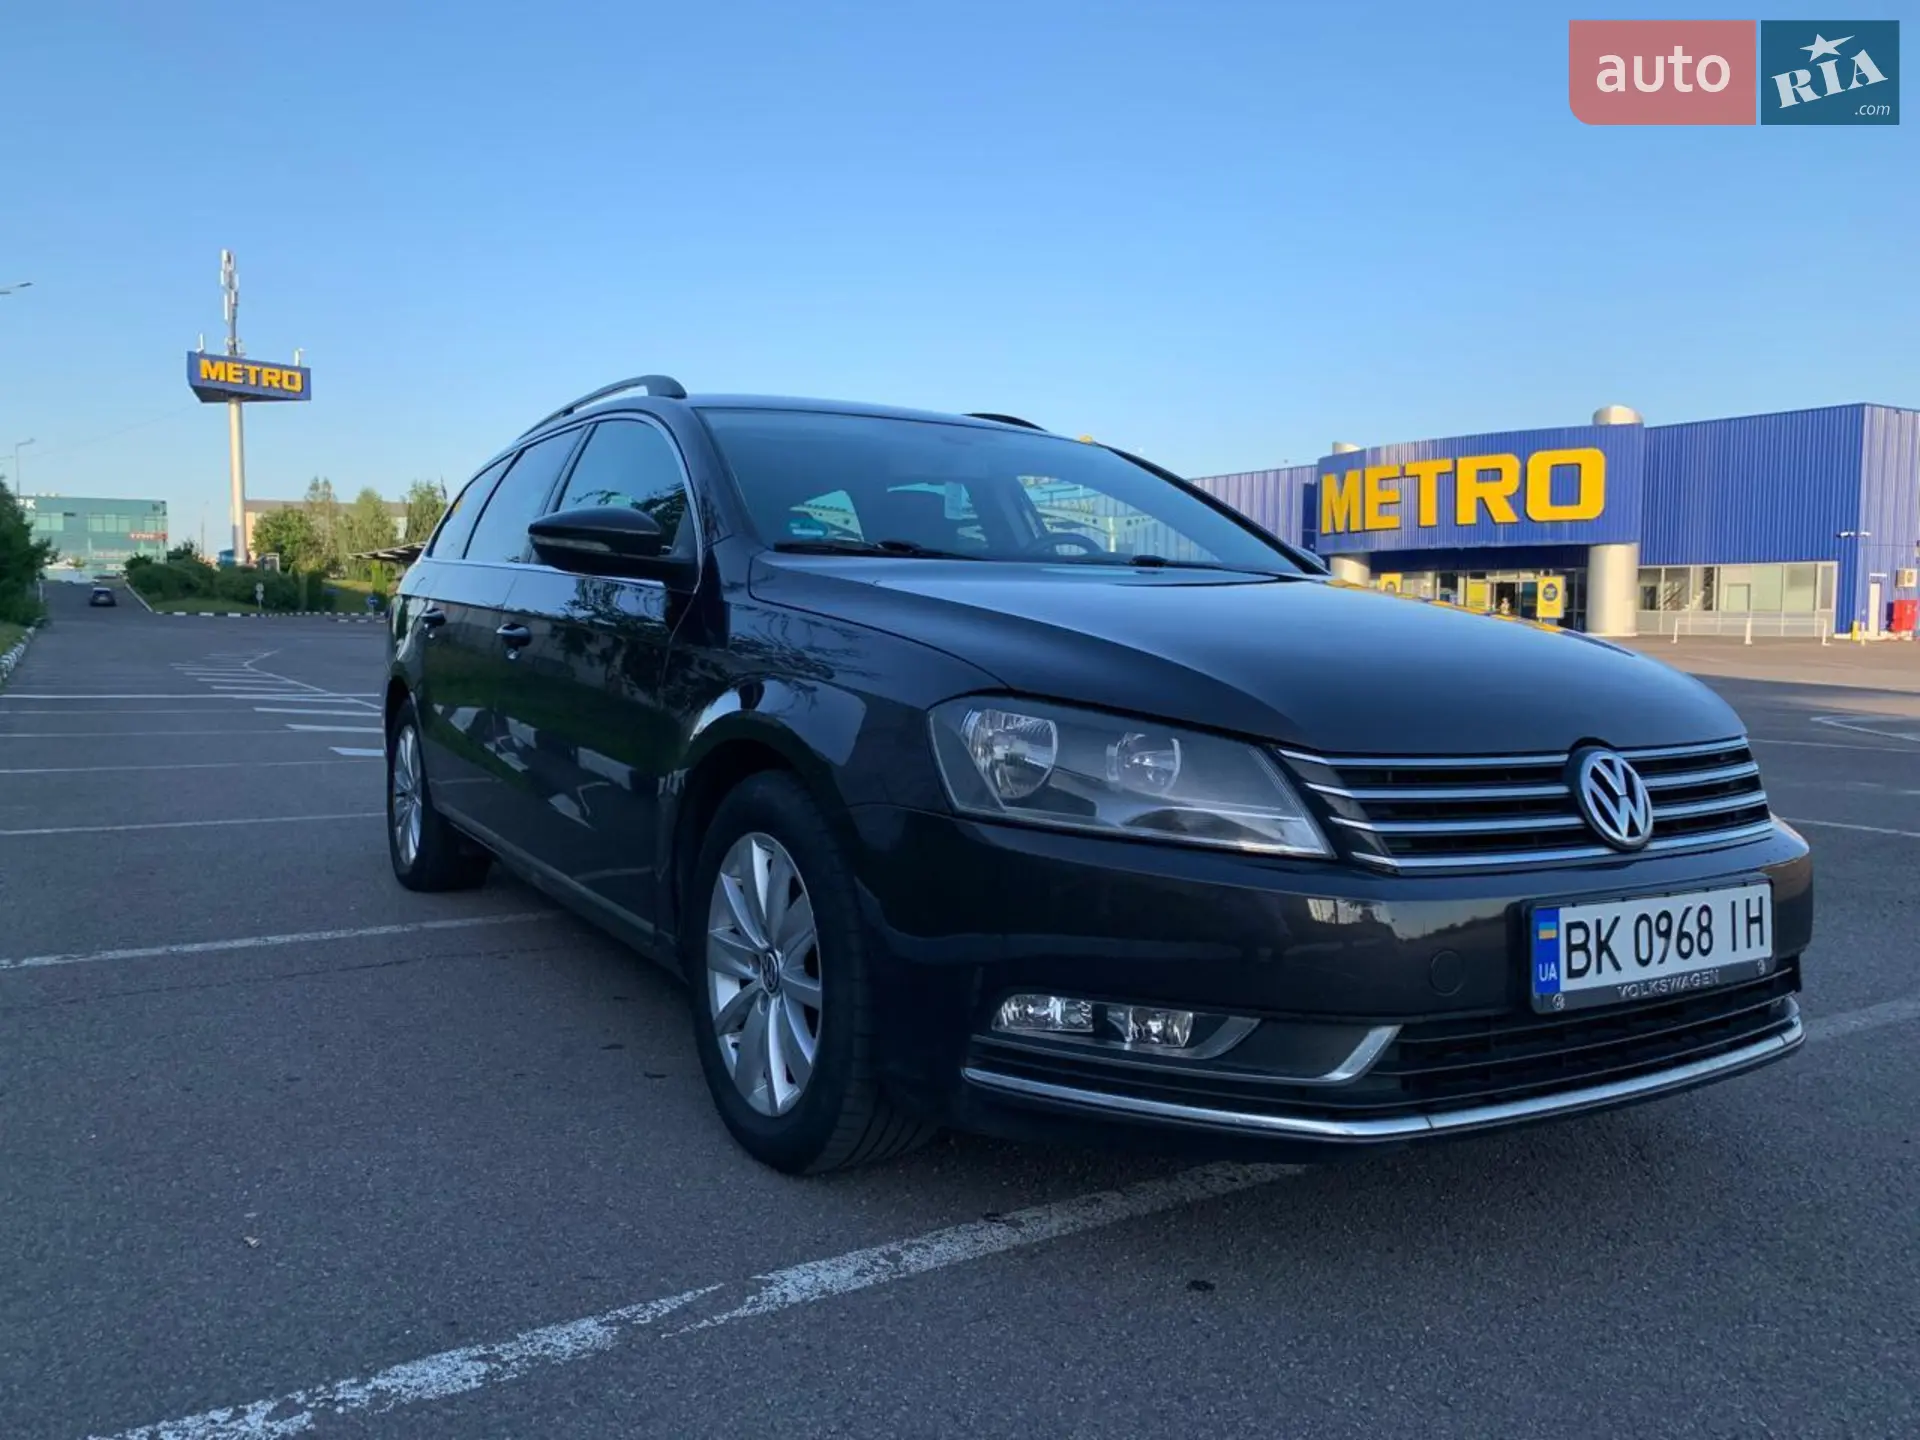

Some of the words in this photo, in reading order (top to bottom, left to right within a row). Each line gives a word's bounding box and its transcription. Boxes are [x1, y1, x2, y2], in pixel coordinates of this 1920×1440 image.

[200, 358, 304, 392] METRO
[1320, 447, 1606, 535] METRO
[1565, 915, 1622, 980] BK
[1634, 904, 1714, 968] 0968
[1730, 896, 1765, 952] IH
[1538, 963, 1558, 982] UA
[1616, 968, 1720, 998] VOLKSWAGEN
